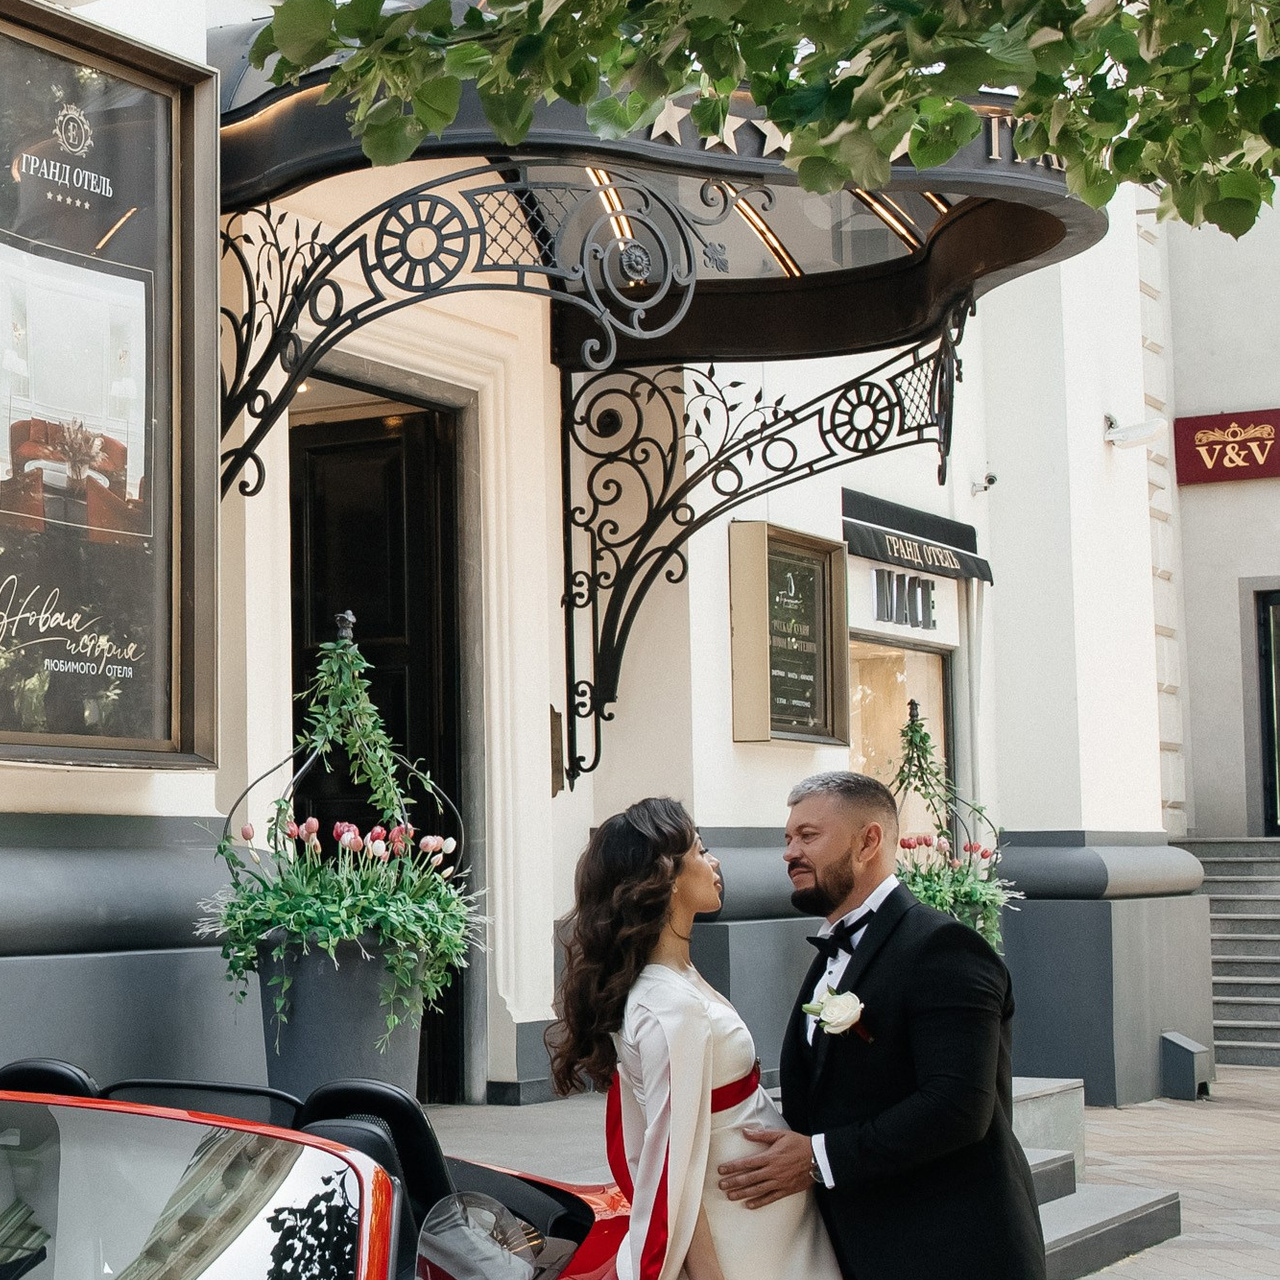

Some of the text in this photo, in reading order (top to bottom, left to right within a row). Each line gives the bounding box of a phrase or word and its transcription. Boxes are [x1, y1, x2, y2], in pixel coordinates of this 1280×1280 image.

[21, 153, 114, 198] ГРАНД ОТЕЛЬ
[1195, 440, 1275, 470] V&V
[884, 534, 961, 570] ГРАНД ОТЕЛЬ
[43, 658, 134, 679] ЛЮБИМОГО ОТЕЛЯ
